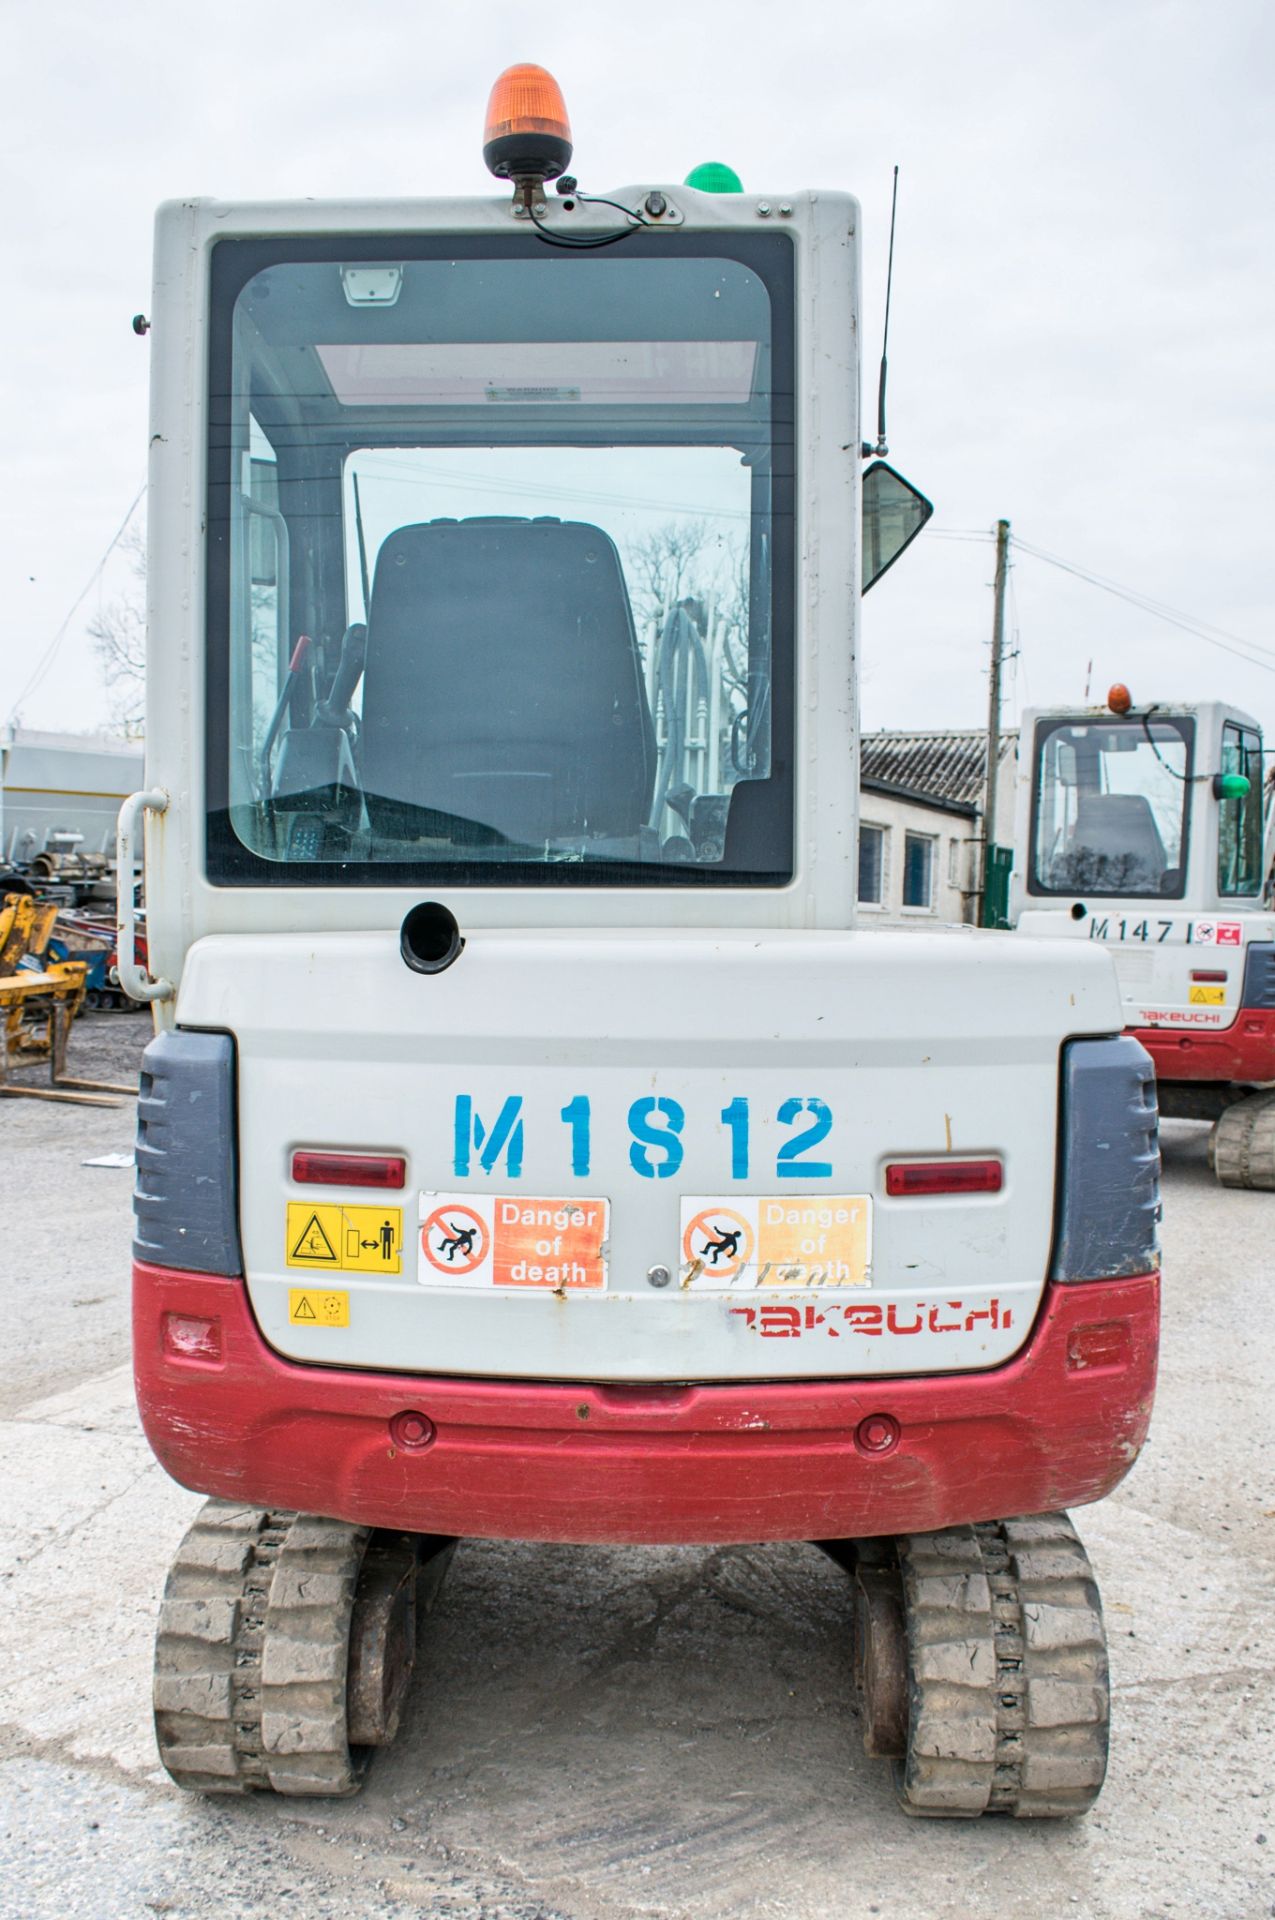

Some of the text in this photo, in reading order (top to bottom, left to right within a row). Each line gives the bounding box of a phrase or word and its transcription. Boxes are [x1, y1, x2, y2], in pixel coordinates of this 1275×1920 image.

[501, 1203, 597, 1231] Danger
[766, 1204, 859, 1228] Danger
[535, 1236, 562, 1257] of
[800, 1235, 827, 1255] of
[510, 1260, 587, 1283] death
